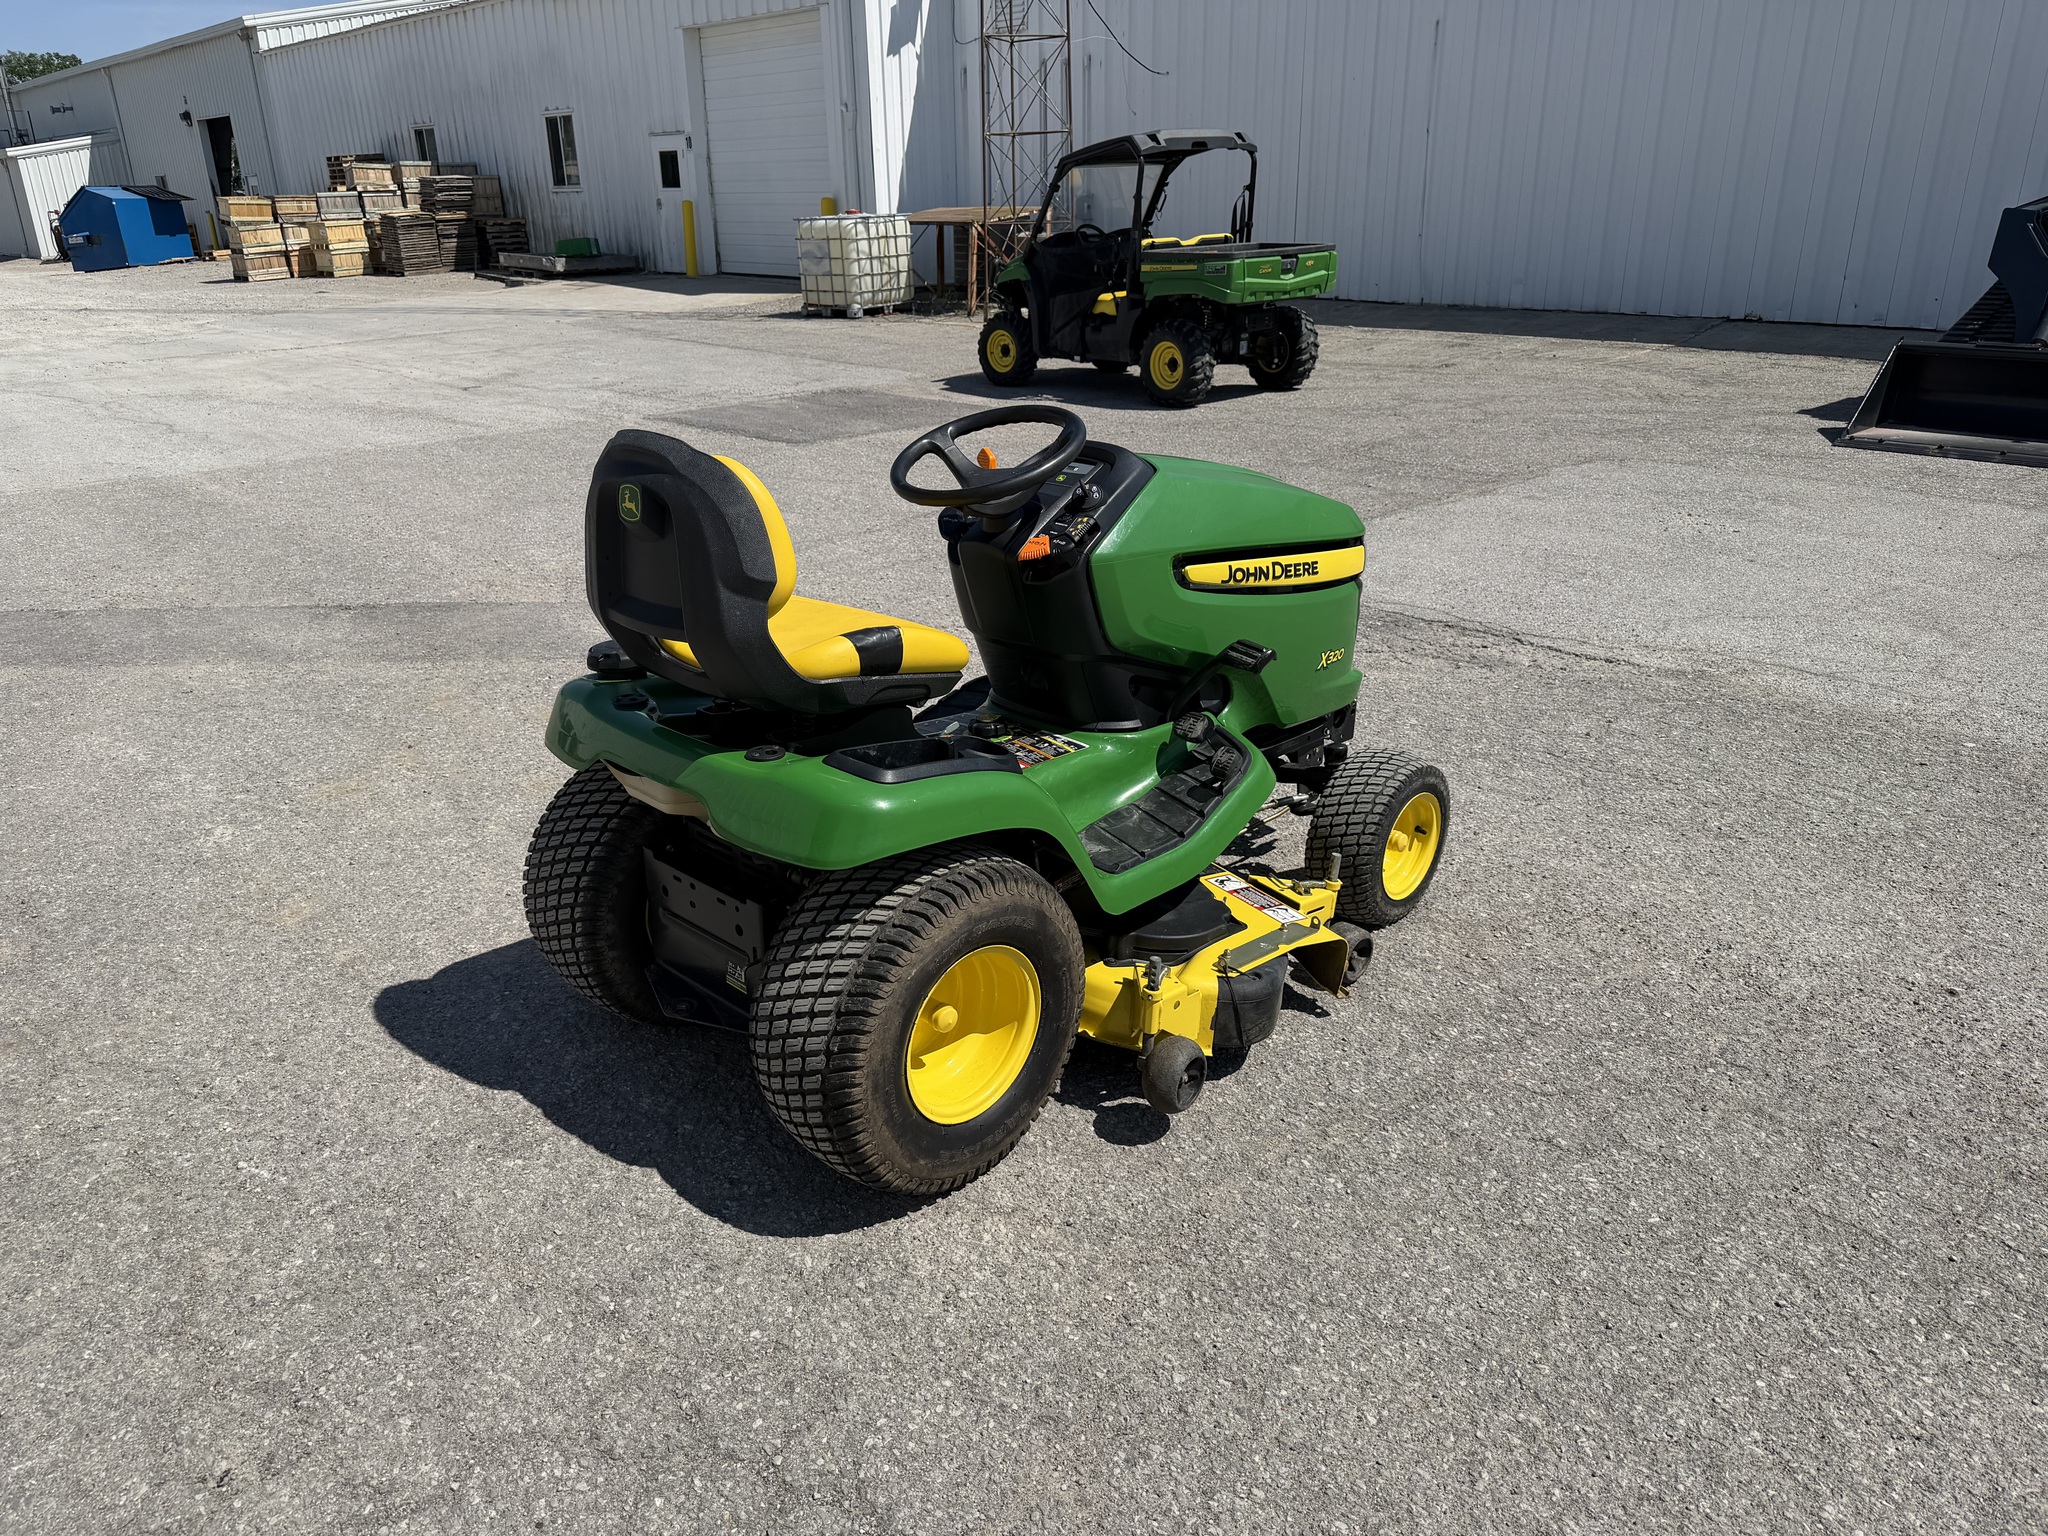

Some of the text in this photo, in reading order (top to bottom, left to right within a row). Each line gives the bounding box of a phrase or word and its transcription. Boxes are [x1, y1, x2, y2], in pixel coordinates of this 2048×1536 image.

[1221, 560, 1319, 584] JOHN DEERE
[1315, 647, 1346, 672] X320
